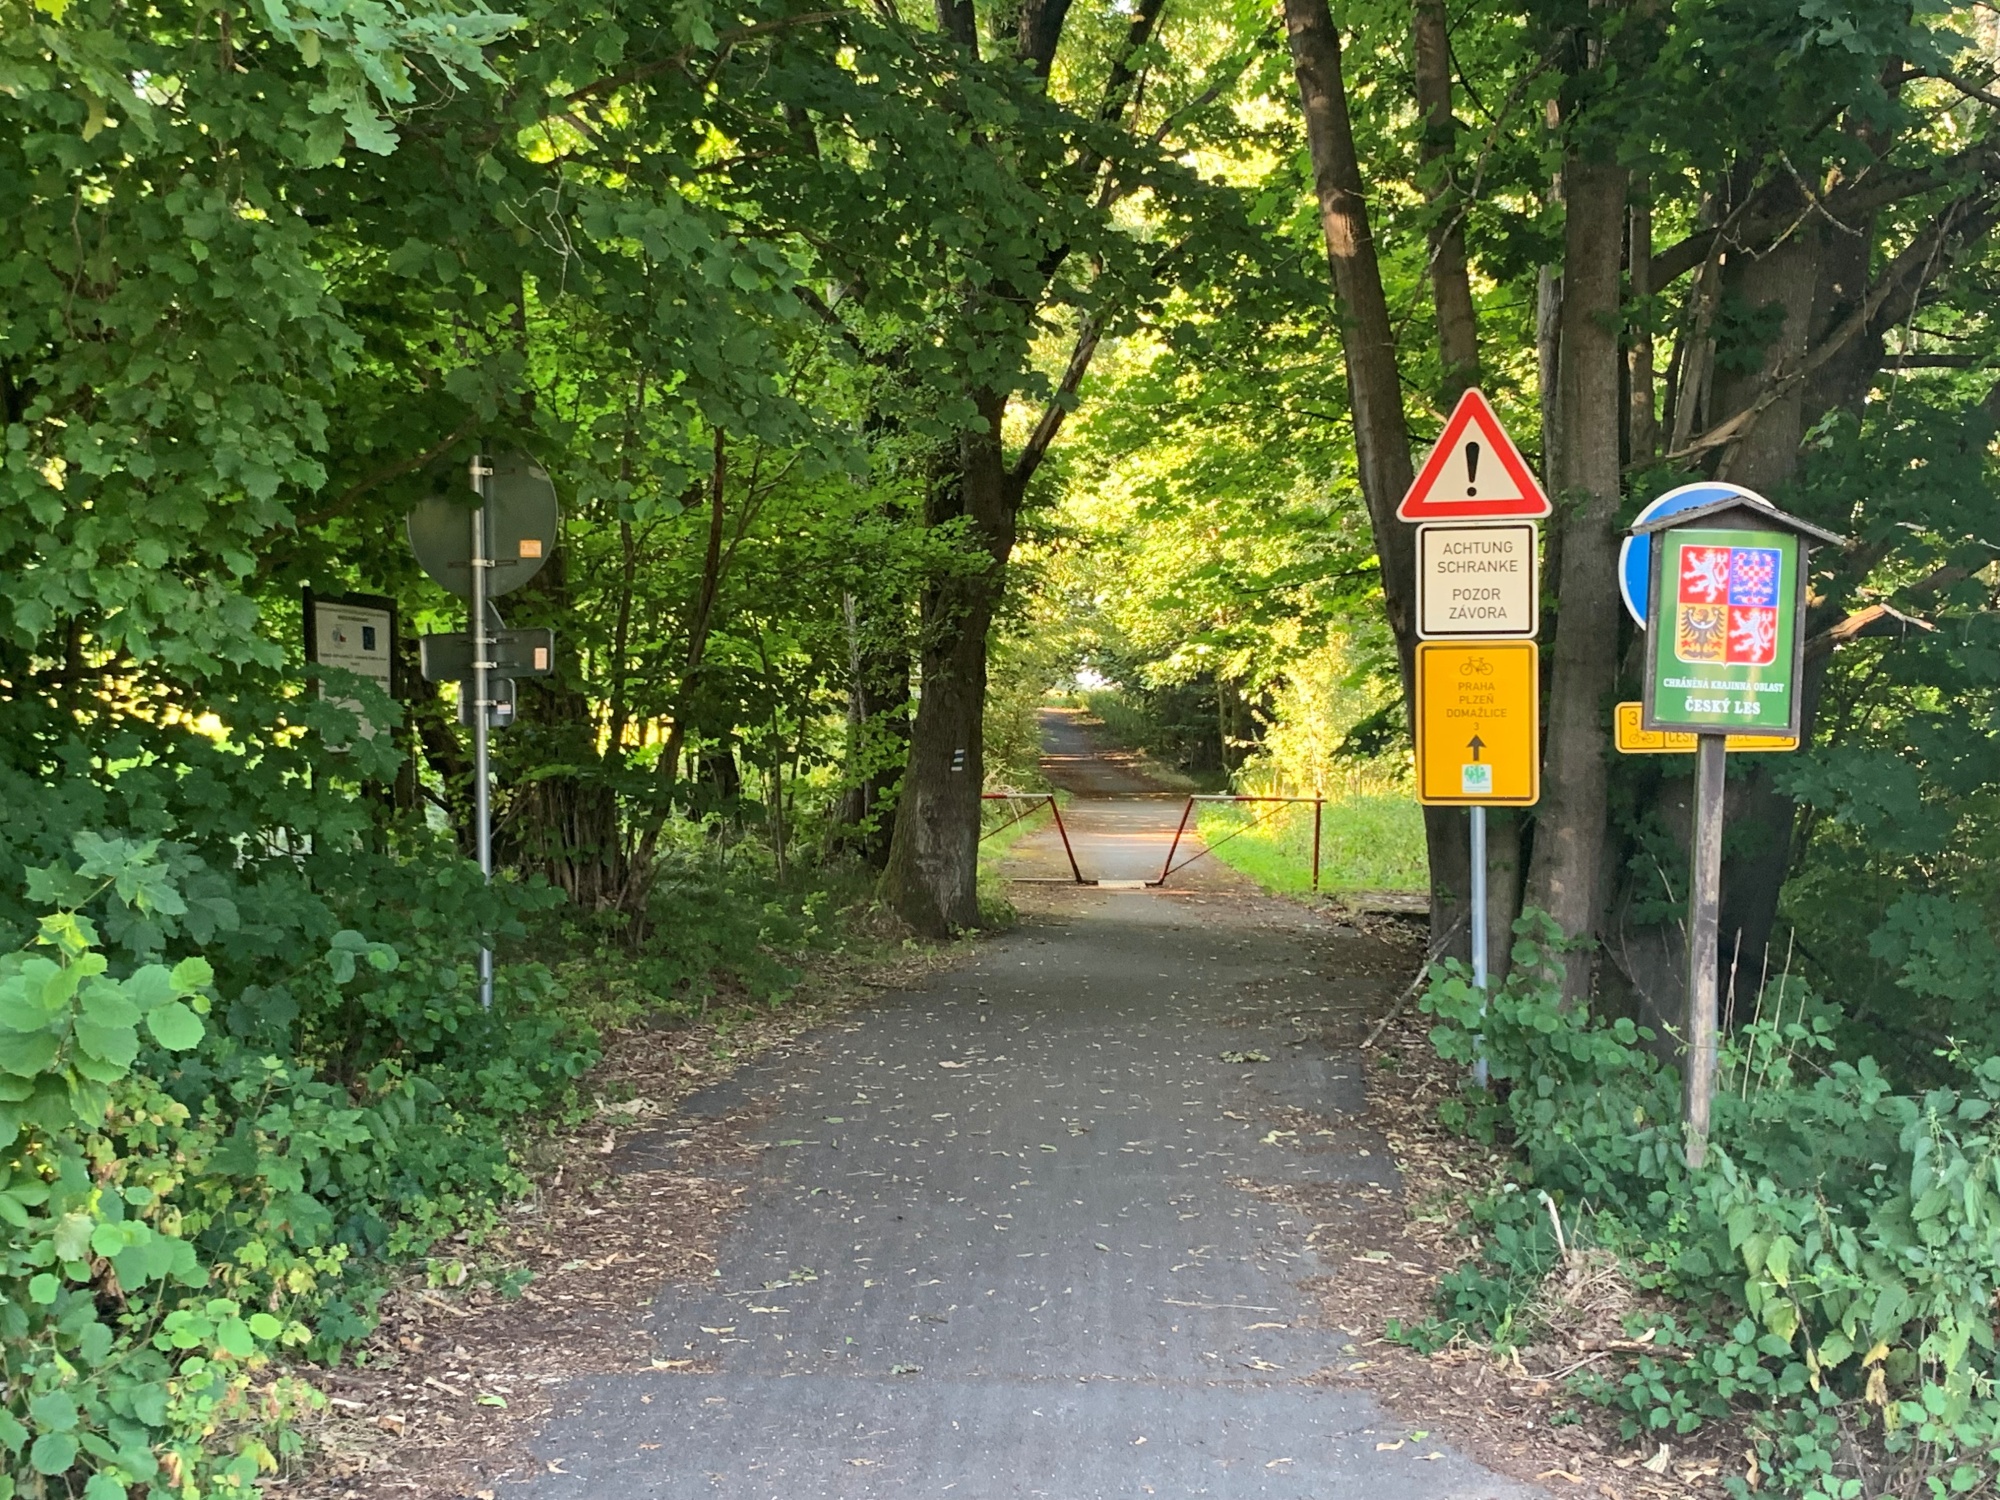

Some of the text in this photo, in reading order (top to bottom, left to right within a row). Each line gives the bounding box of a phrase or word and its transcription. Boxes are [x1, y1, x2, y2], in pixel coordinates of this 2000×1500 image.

[1443, 541, 1513, 555] ACHTUNG
[1437, 560, 1518, 573] SCHRANKE
[1452, 588, 1501, 600] POZOR
[1449, 604, 1507, 619] ZÁVORA
[1458, 682, 1495, 690] PRAHA
[1753, 682, 1785, 692] OBLAST
[1459, 693, 1494, 704] PLZEŇ
[1685, 696, 1761, 714] ČESKÝ LES
[1446, 707, 1507, 717] DOMAŽLICE
[1629, 711, 1638, 725] 3
[1473, 722, 1479, 730] 3
